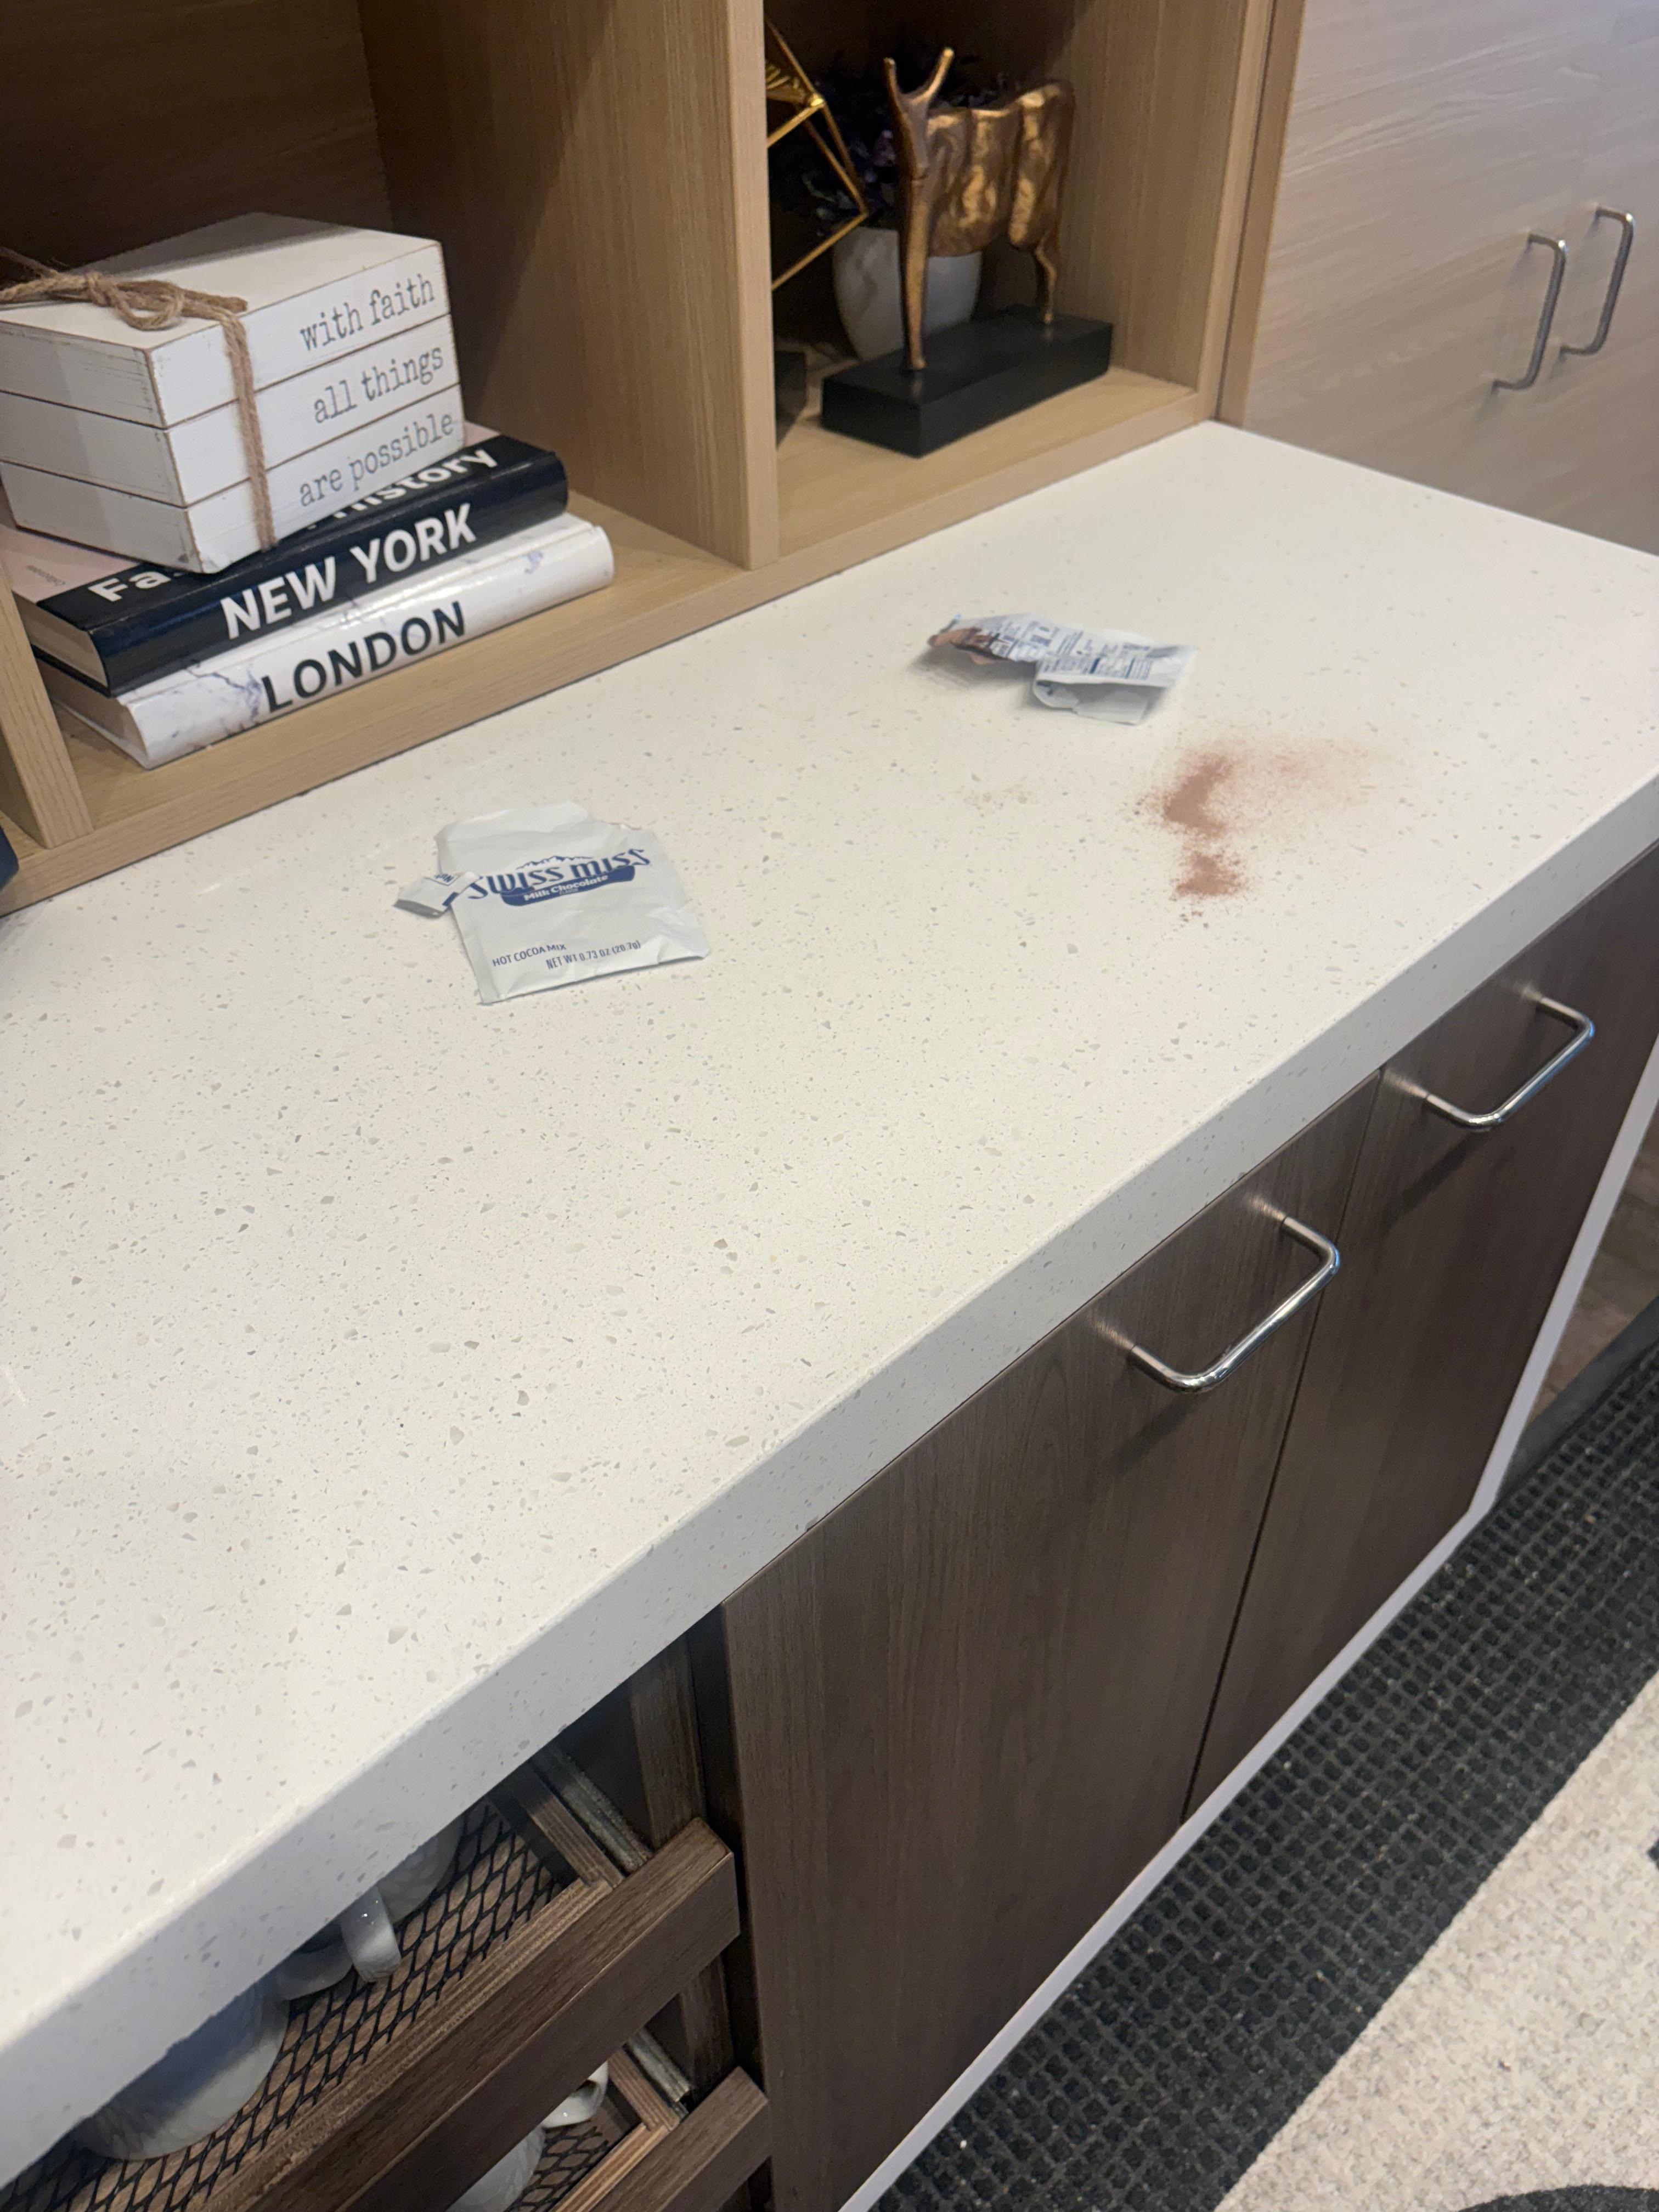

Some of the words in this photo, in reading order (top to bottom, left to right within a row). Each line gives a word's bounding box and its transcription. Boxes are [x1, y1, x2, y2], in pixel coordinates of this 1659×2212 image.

[300, 302, 364, 351] with
[369, 273, 436, 326] faith
[314, 379, 358, 424] all
[361, 347, 444, 402] things
[300, 469, 343, 507] are
[348, 414, 453, 492] possible
[220, 556, 336, 640] NEW
[349, 503, 477, 584] YORK
[261, 601, 465, 713] LONDON
[523, 889, 550, 901] Milk
[550, 874, 609, 894] Chocolate
[492, 954, 512, 967] HOT
[514, 946, 546, 962] COCOA
[546, 956, 563, 970] NET
[563, 954, 578, 964] WT
[579, 950, 599, 962] 0.73
